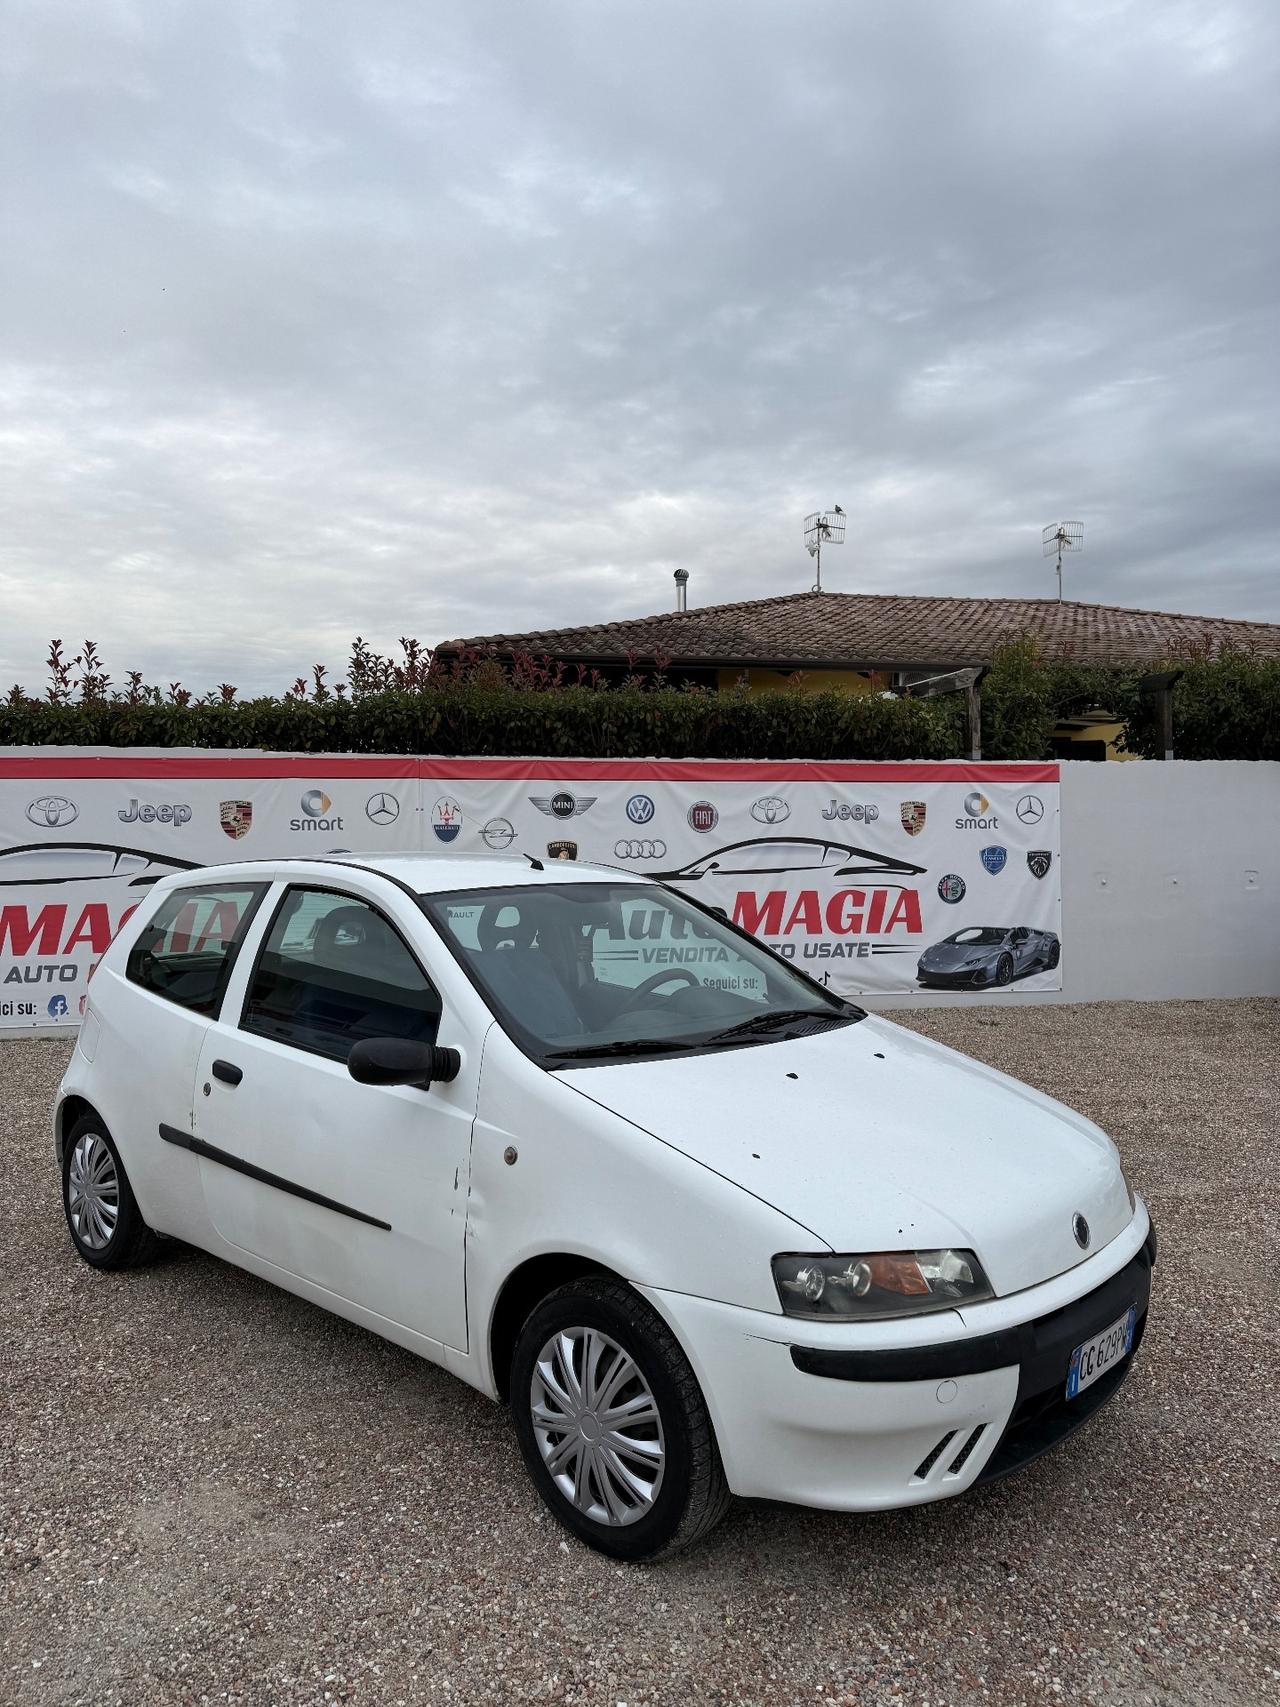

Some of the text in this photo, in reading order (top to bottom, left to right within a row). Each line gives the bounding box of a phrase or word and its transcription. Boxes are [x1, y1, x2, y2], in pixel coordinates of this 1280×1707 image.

[117, 799, 192, 826] Jeep
[552, 800, 574, 810] MINI
[822, 799, 880, 825] Jeep
[289, 816, 344, 832] smart
[695, 809, 714, 825] FIAT
[955, 816, 999, 830] smart
[641, 947, 729, 964] VENDITA
[803, 942, 871, 958] USATE
[3, 963, 78, 984] AUTO
[703, 975, 759, 990] Seguici su:
[17, 1003, 37, 1015] su:
